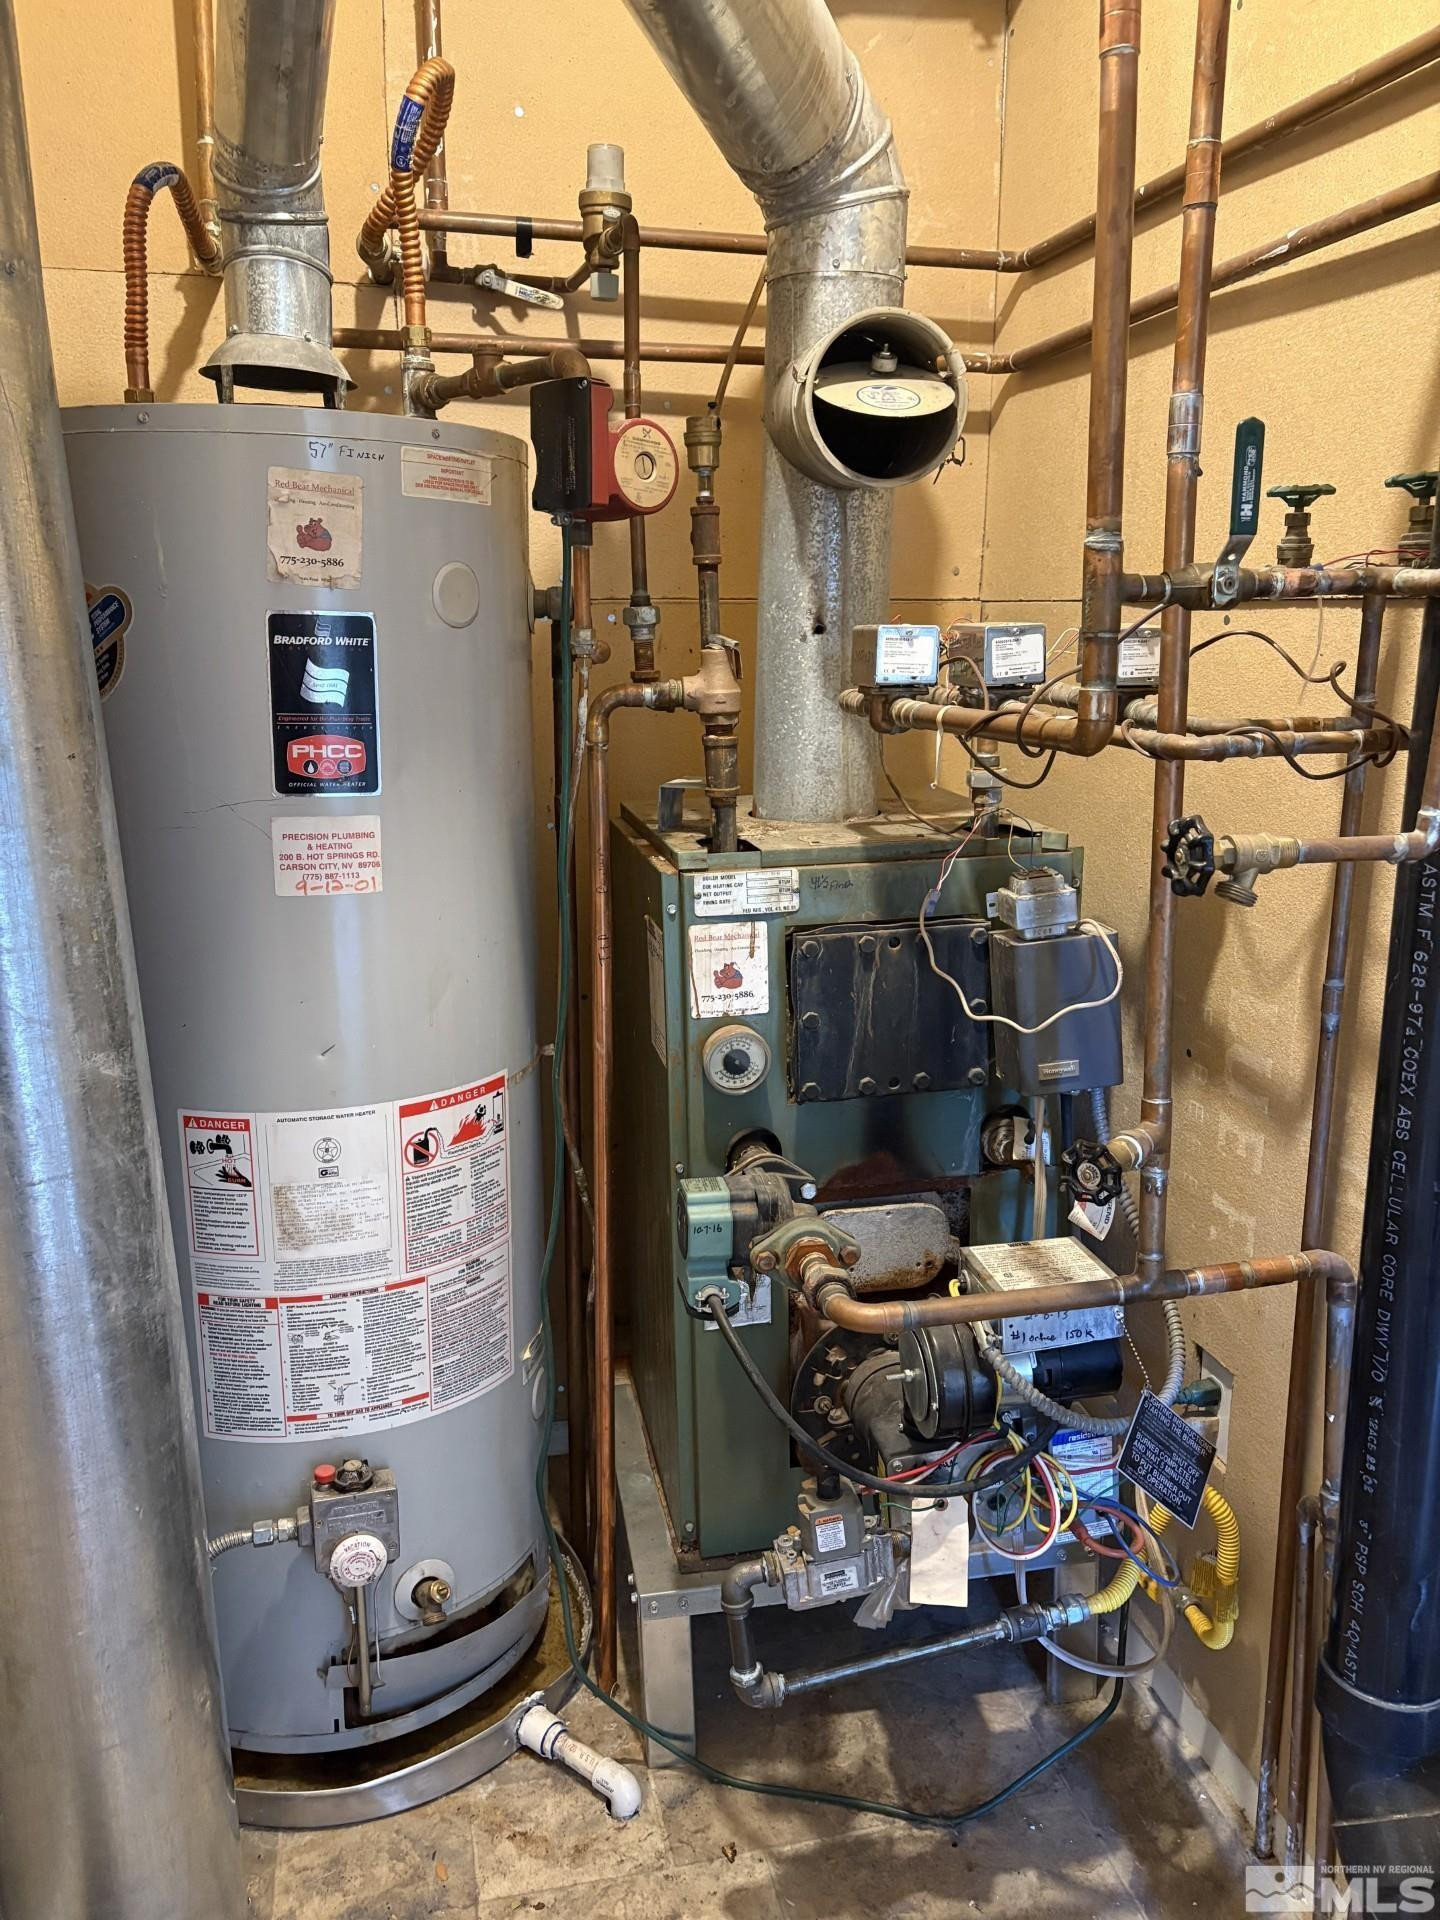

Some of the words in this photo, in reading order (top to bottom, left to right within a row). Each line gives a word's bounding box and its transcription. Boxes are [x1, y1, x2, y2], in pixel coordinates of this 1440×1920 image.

[275, 480, 290, 488] Red
[292, 481, 309, 490] Bear
[311, 483, 355, 496] Mechanical
[280, 556, 344, 567] 775-230-5886
[274, 635, 332, 646] BRADFORD
[335, 636, 369, 646] WHITE
[292, 745, 362, 758] PHCC
[331, 832, 375, 840] PLUMBING
[279, 853, 294, 861] 200
[327, 852, 364, 860] SPRINGS
[279, 863, 316, 871] CARSON
[319, 863, 340, 871] CITY,
[341, 862, 353, 870] NV
[303, 873, 322, 881] (775)
[324, 872, 360, 880] 887-1113
[1416, 863, 1439, 919] ASTM
[1043, 1064, 1077, 1076] Honeywell
[1399, 1047, 1420, 1099] COEX
[441, 1086, 486, 1107] DANGER
[200, 1119, 246, 1130] DANGER
[1394, 1103, 1412, 1141] ABS
[1384, 1150, 1408, 1248] CELLULAR
[1378, 1253, 1397, 1302] CORE
[1373, 1307, 1392, 1350] DWV
[1143, 1401, 1171, 1427] STARTING
[1171, 1422, 1182, 1437] THE
[1147, 1394, 1172, 1419] LIGHTING
[1173, 1415, 1213, 1453] INSTRUCTIONS
[1133, 1440, 1145, 1454] AND
[1145, 1449, 1160, 1465] WAIT
[1164, 1465, 1190, 1490] MINUTES
[1135, 1431, 1160, 1456] BURNER
[1160, 1451, 1197, 1485] COMPLETELY
[1172, 1452, 1187, 1468] SHUT
[1187, 1464, 1200, 1478] OFF
[1132, 1451, 1139, 1462] TO
[1140, 1458, 1152, 1473] PUT
[1152, 1467, 1178, 1493] BURNER
[1178, 1489, 1192, 1505] OUT
[1137, 1466, 1147, 1477] OF
[1146, 1473, 1182, 1505] OPERATION
[1354, 1541, 1369, 1576] PSP
[1350, 1579, 1367, 1616] SCH
